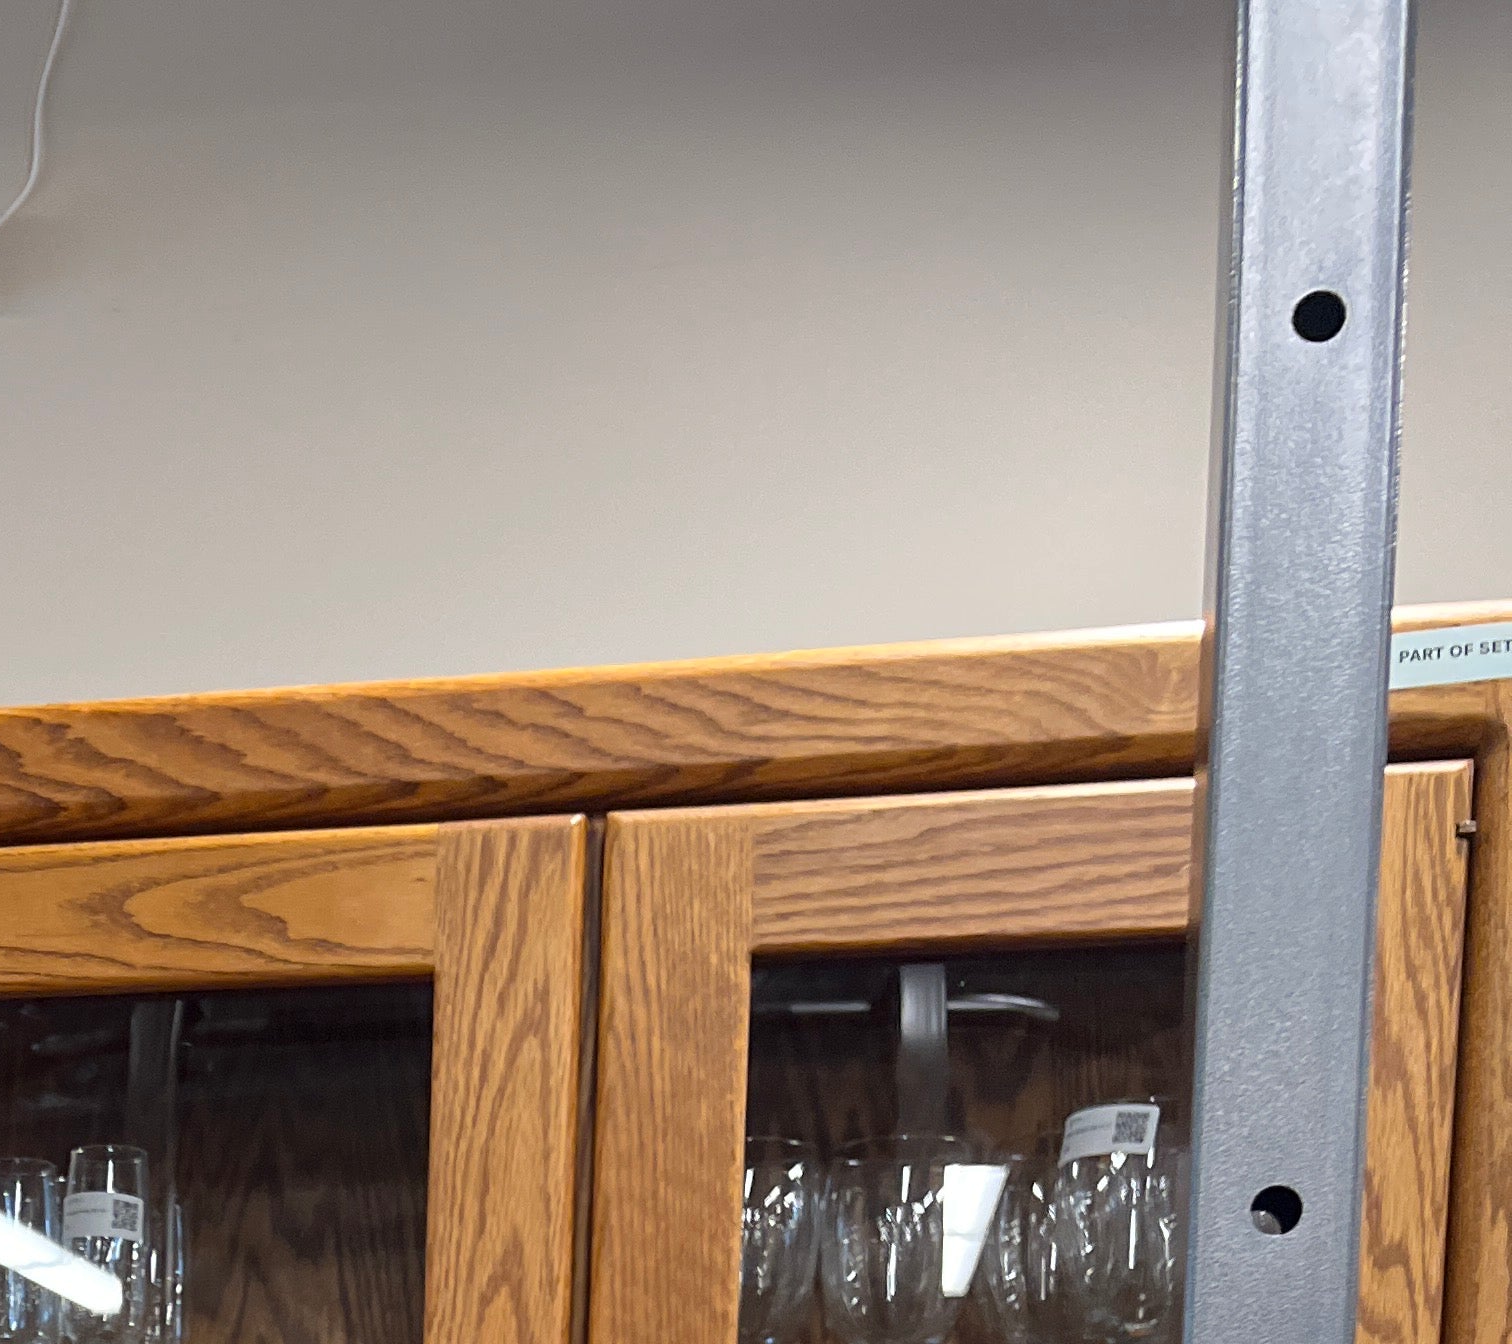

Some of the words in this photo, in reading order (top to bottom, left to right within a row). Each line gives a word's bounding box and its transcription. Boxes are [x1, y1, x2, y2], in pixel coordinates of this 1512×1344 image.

[1399, 646, 1444, 663] PART
[1450, 644, 1474, 658] OF
[1480, 639, 1512, 655] SET
